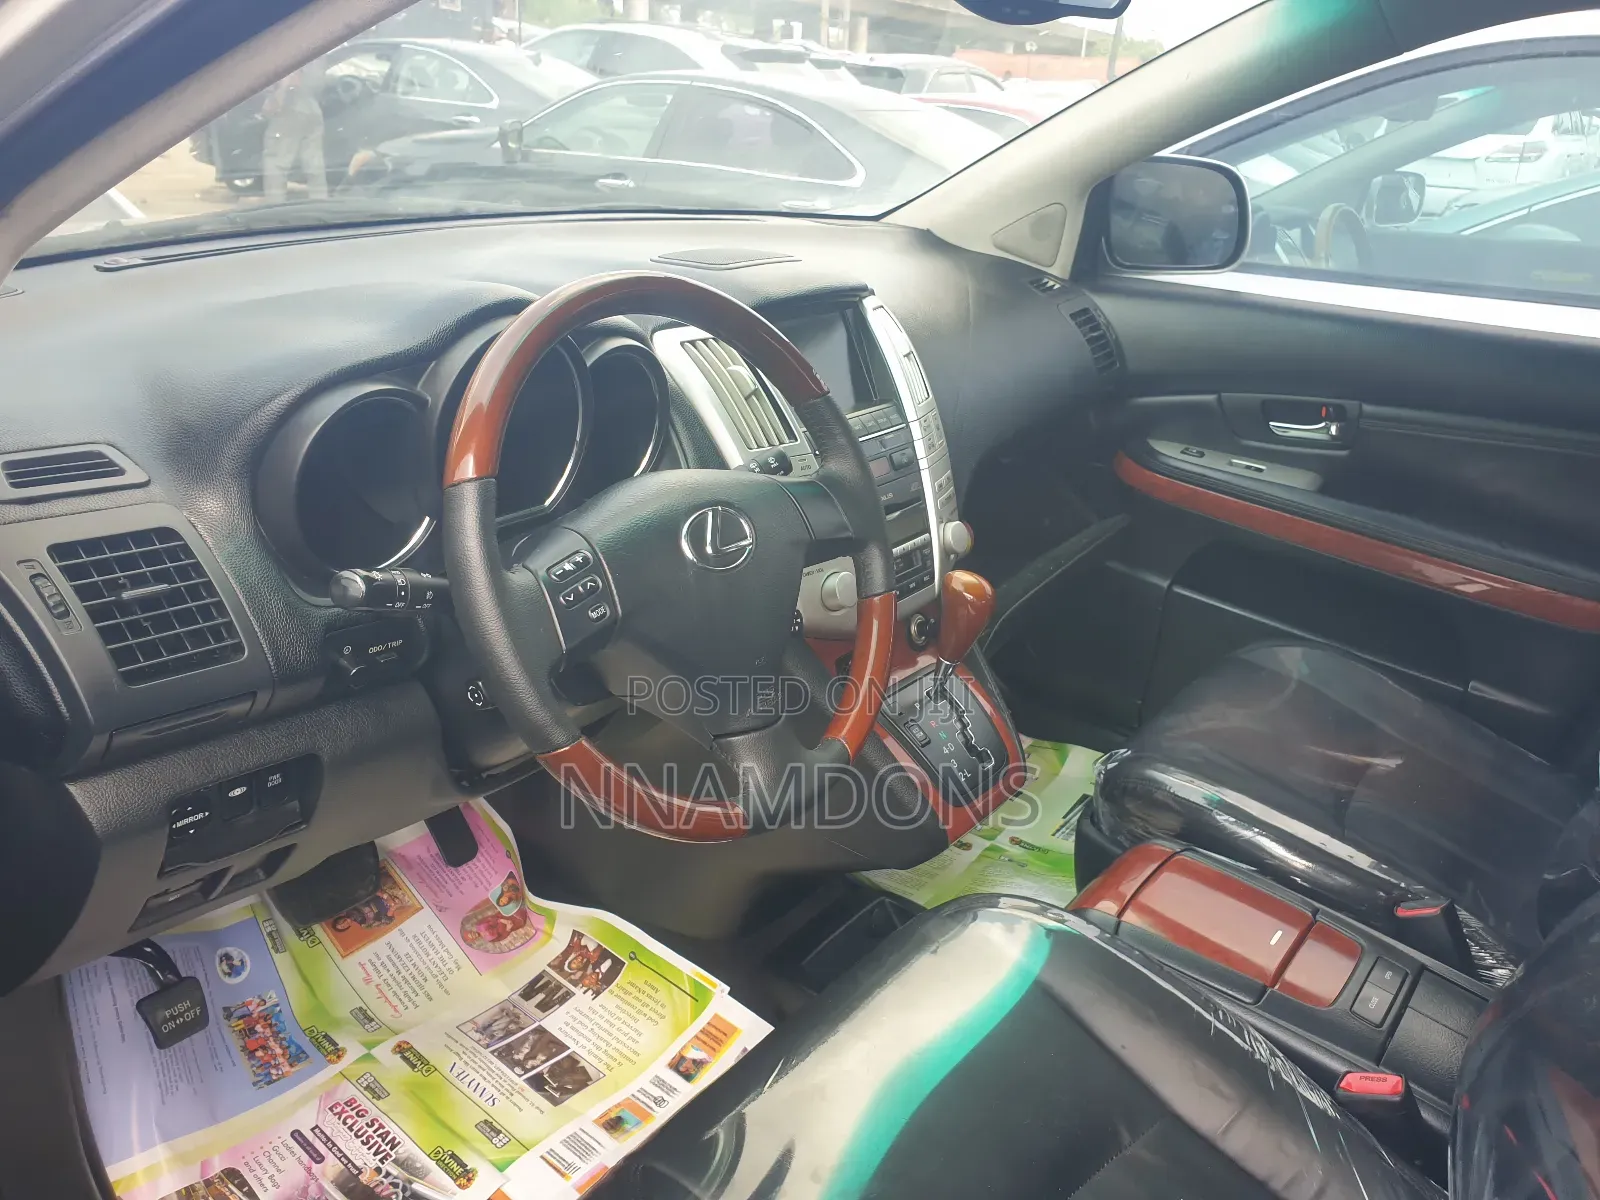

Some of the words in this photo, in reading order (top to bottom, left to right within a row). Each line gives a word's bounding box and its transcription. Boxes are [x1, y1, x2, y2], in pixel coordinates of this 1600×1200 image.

[590, 605, 607, 619] MODE
[368, 639, 403, 654] ODO/TRIP
[950, 759, 958, 768] 3
[176, 812, 204, 828] MIRROR
[396, 927, 406, 937] the
[426, 923, 436, 935] you
[411, 933, 431, 958] MOTHER
[419, 929, 440, 955] HARVEST
[372, 950, 382, 961] our
[403, 951, 413, 962] EZE
[408, 942, 427, 966] occasion
[437, 954, 448, 967] THE
[442, 947, 453, 960] God
[379, 960, 391, 974] with
[425, 964, 438, 979] great
[428, 956, 448, 981] ELEGANT
[445, 965, 454, 975] OF
[387, 971, 405, 991] rejoice
[434, 978, 445, 990] this
[614, 981, 632, 998] affairs
[613, 991, 637, 1012] continue
[631, 993, 642, 1003] our
[640, 1000, 650, 1009] all
[164, 999, 191, 1018] PUSH
[572, 1004, 594, 1023] journey
[586, 1005, 598, 1015] this
[597, 1002, 616, 1018] Divine
[614, 1002, 639, 1024] Direction
[635, 1008, 647, 1019] will
[648, 1005, 666, 1021] direct
[161, 1019, 176, 1033] ON
[183, 1006, 202, 1024] OFF
[568, 1013, 578, 1022] for
[576, 1019, 588, 1030] God
[603, 1017, 616, 1029] that
[614, 1014, 622, 1022] of
[646, 1015, 658, 1027] God
[568, 1024, 592, 1044] medium
[592, 1020, 613, 1038] marital
[615, 1024, 629, 1038] pray
[620, 1019, 642, 1038] Harvest
[587, 1026, 612, 1048] thanking
[627, 1035, 639, 1046] and
[578, 1043, 587, 1051] of
[590, 1041, 602, 1052] this
[611, 1034, 641, 1059] successful
[585, 1047, 604, 1064] family
[601, 1048, 618, 1063] using
[610, 1044, 636, 1066] continue
[602, 1061, 614, 1072] The
[616, 1060, 623, 1068] is
[358, 1077, 369, 1087] 25
[363, 1072, 374, 1083] 20
[343, 1097, 369, 1118] BIG
[365, 1117, 402, 1152] STAN
[328, 1101, 393, 1166] EXCLUSIVE
[497, 1132, 509, 1144] 25
[491, 1136, 503, 1148] 20
[272, 1145, 288, 1161] Gucci
[326, 1141, 333, 1149] In
[331, 1147, 343, 1158] God
[340, 1155, 348, 1164] we
[347, 1162, 359, 1175] trust
[262, 1150, 286, 1174] Channel
[281, 1140, 296, 1157] Ladies
[295, 1156, 319, 1182] handbags
[243, 1161, 256, 1173] and
[253, 1173, 269, 1193] others
[253, 1155, 269, 1175] Luxury
[268, 1174, 281, 1189] Bags
